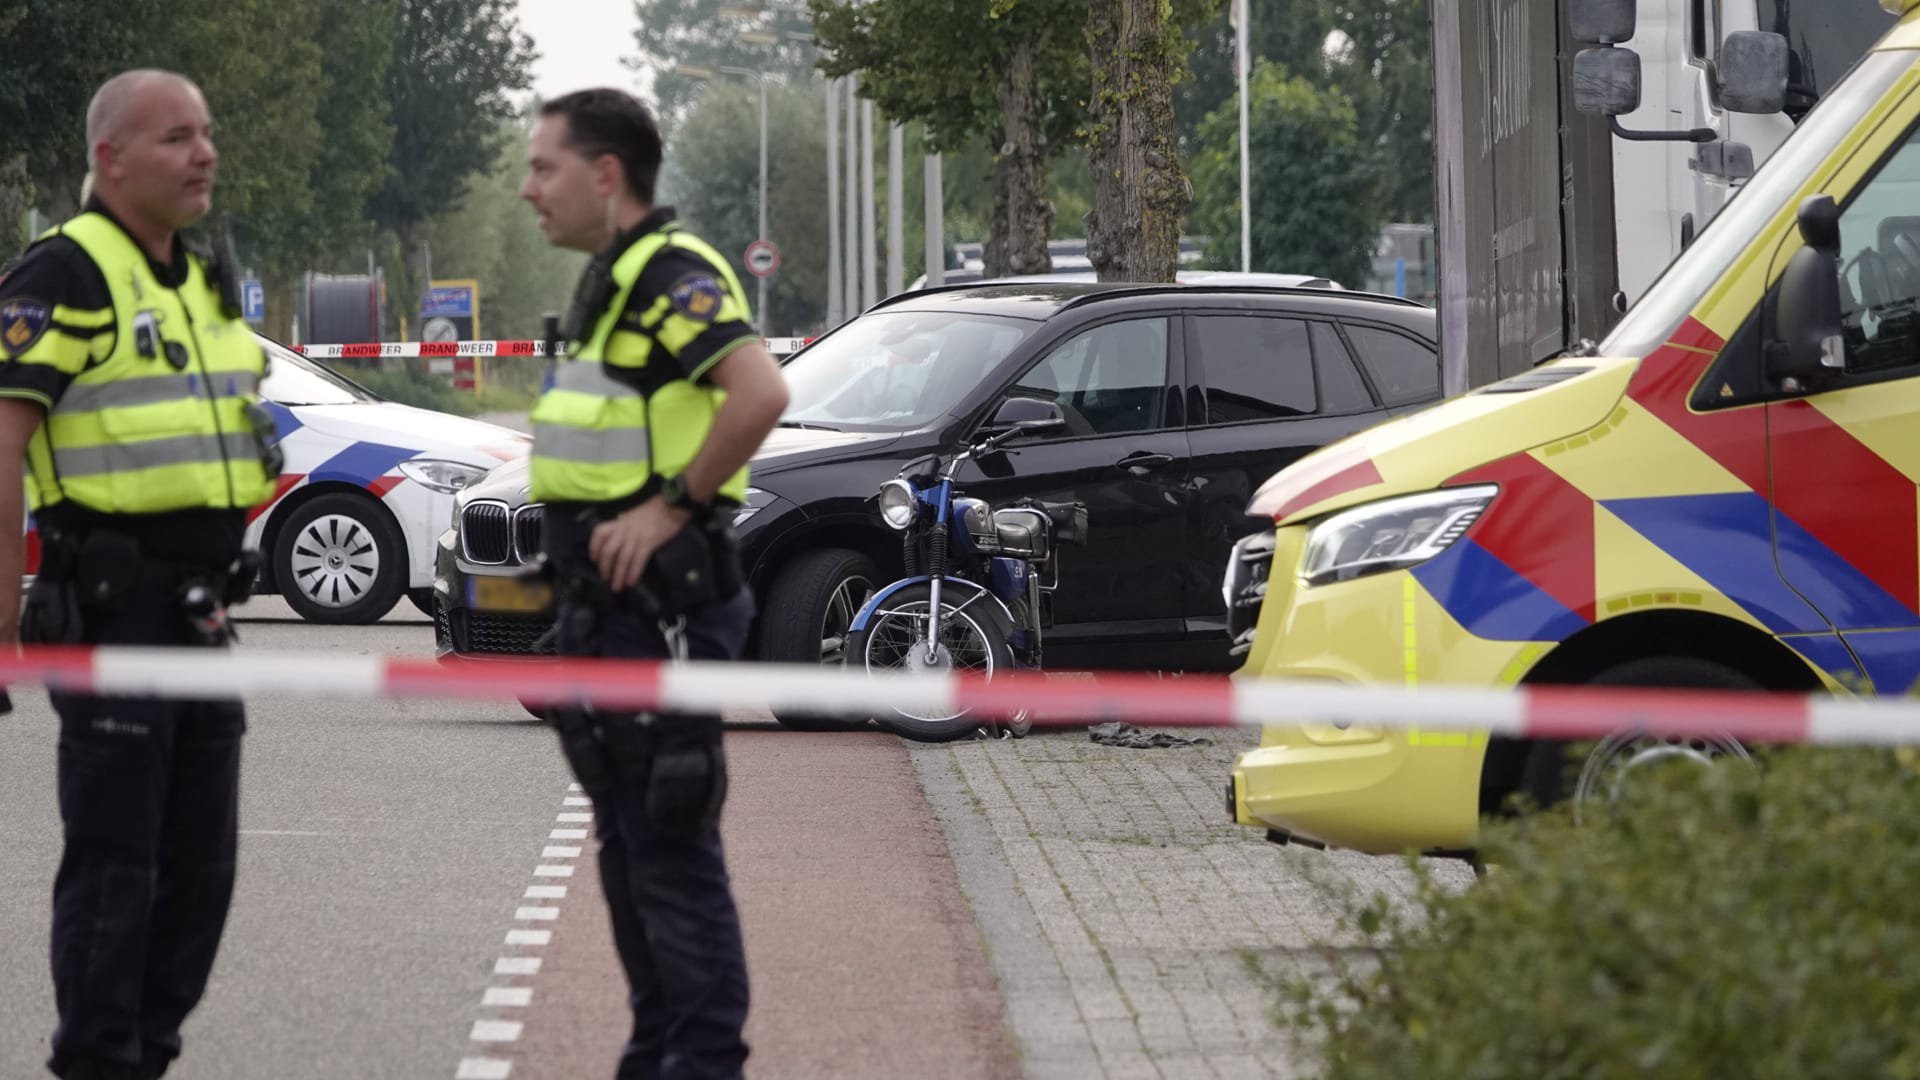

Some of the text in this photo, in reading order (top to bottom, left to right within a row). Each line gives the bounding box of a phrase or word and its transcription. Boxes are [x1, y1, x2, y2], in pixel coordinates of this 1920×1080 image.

[249, 281, 263, 315] P
[327, 344, 402, 356] BRANDWEER
[420, 342, 494, 355] BRANDWEER
